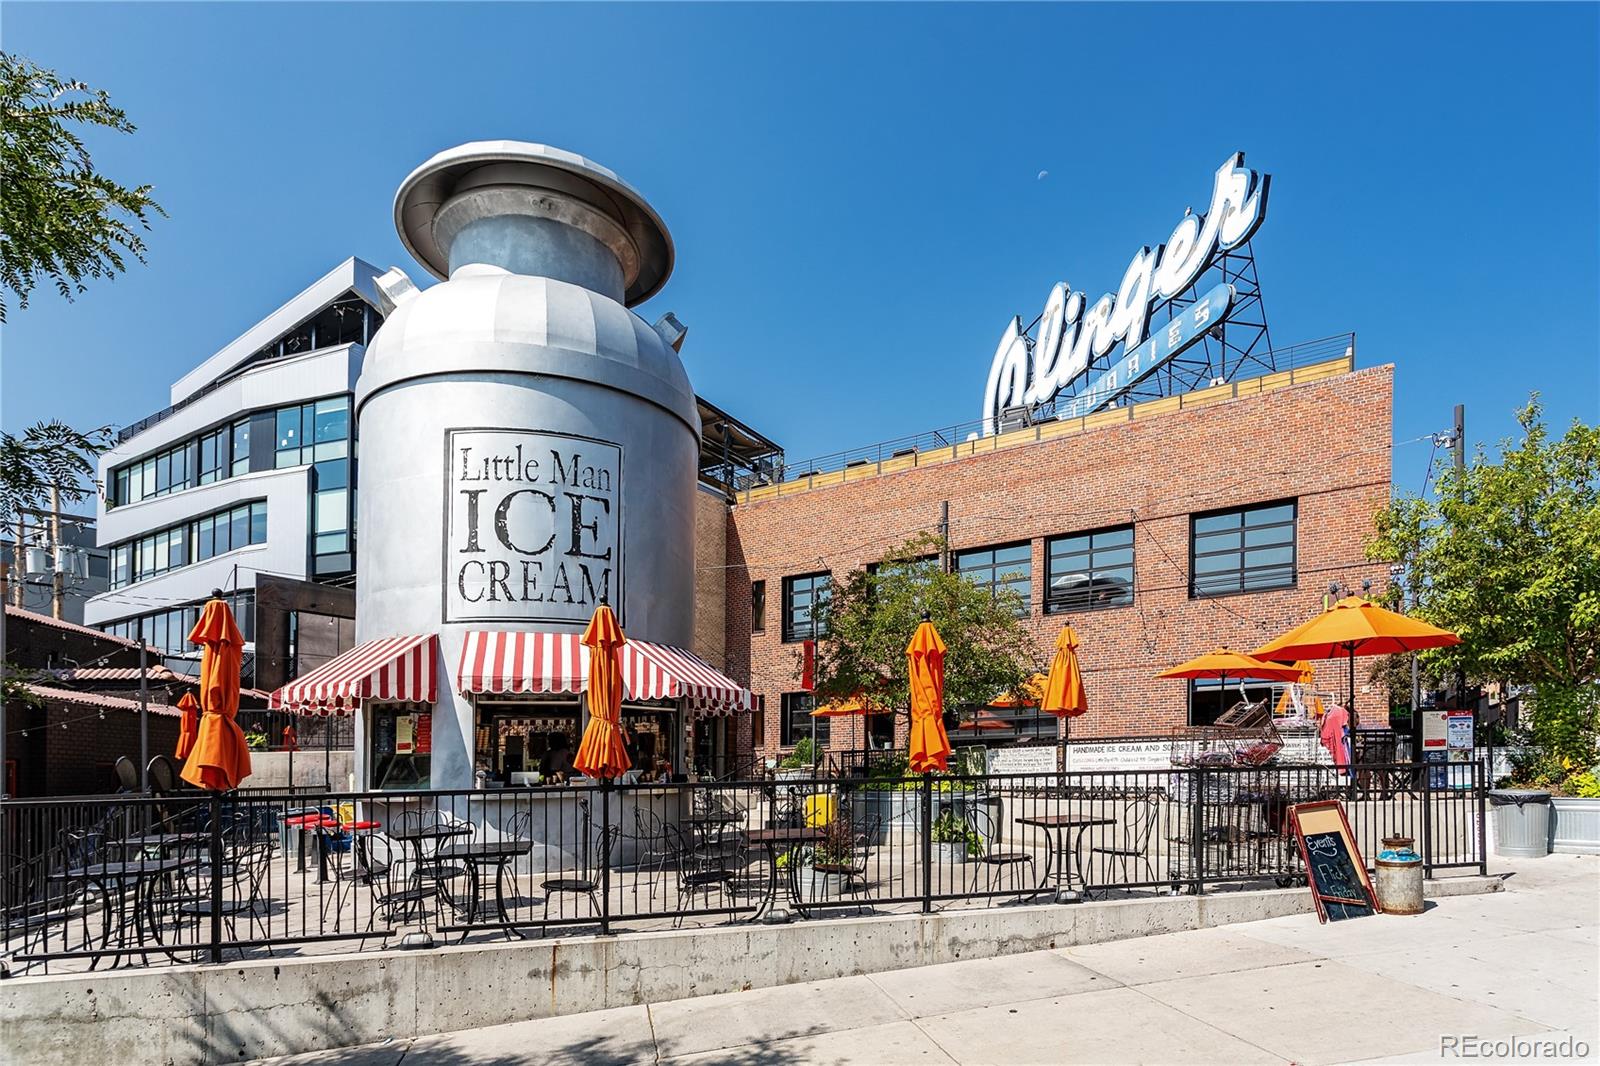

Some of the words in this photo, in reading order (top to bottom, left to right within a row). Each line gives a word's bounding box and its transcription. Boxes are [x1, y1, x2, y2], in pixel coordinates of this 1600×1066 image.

[1070, 298, 1210, 419] TUARIES
[459, 444, 540, 483] Little
[549, 449, 612, 492] Man
[459, 488, 612, 561] ICE
[458, 560, 612, 605] CREAM
[1072, 745, 1105, 754] HANDMADE
[1106, 745, 1116, 753] ICE
[1118, 744, 1142, 753] CREAM
[1144, 743, 1160, 752] AND
[1305, 835, 1337, 851] Events
